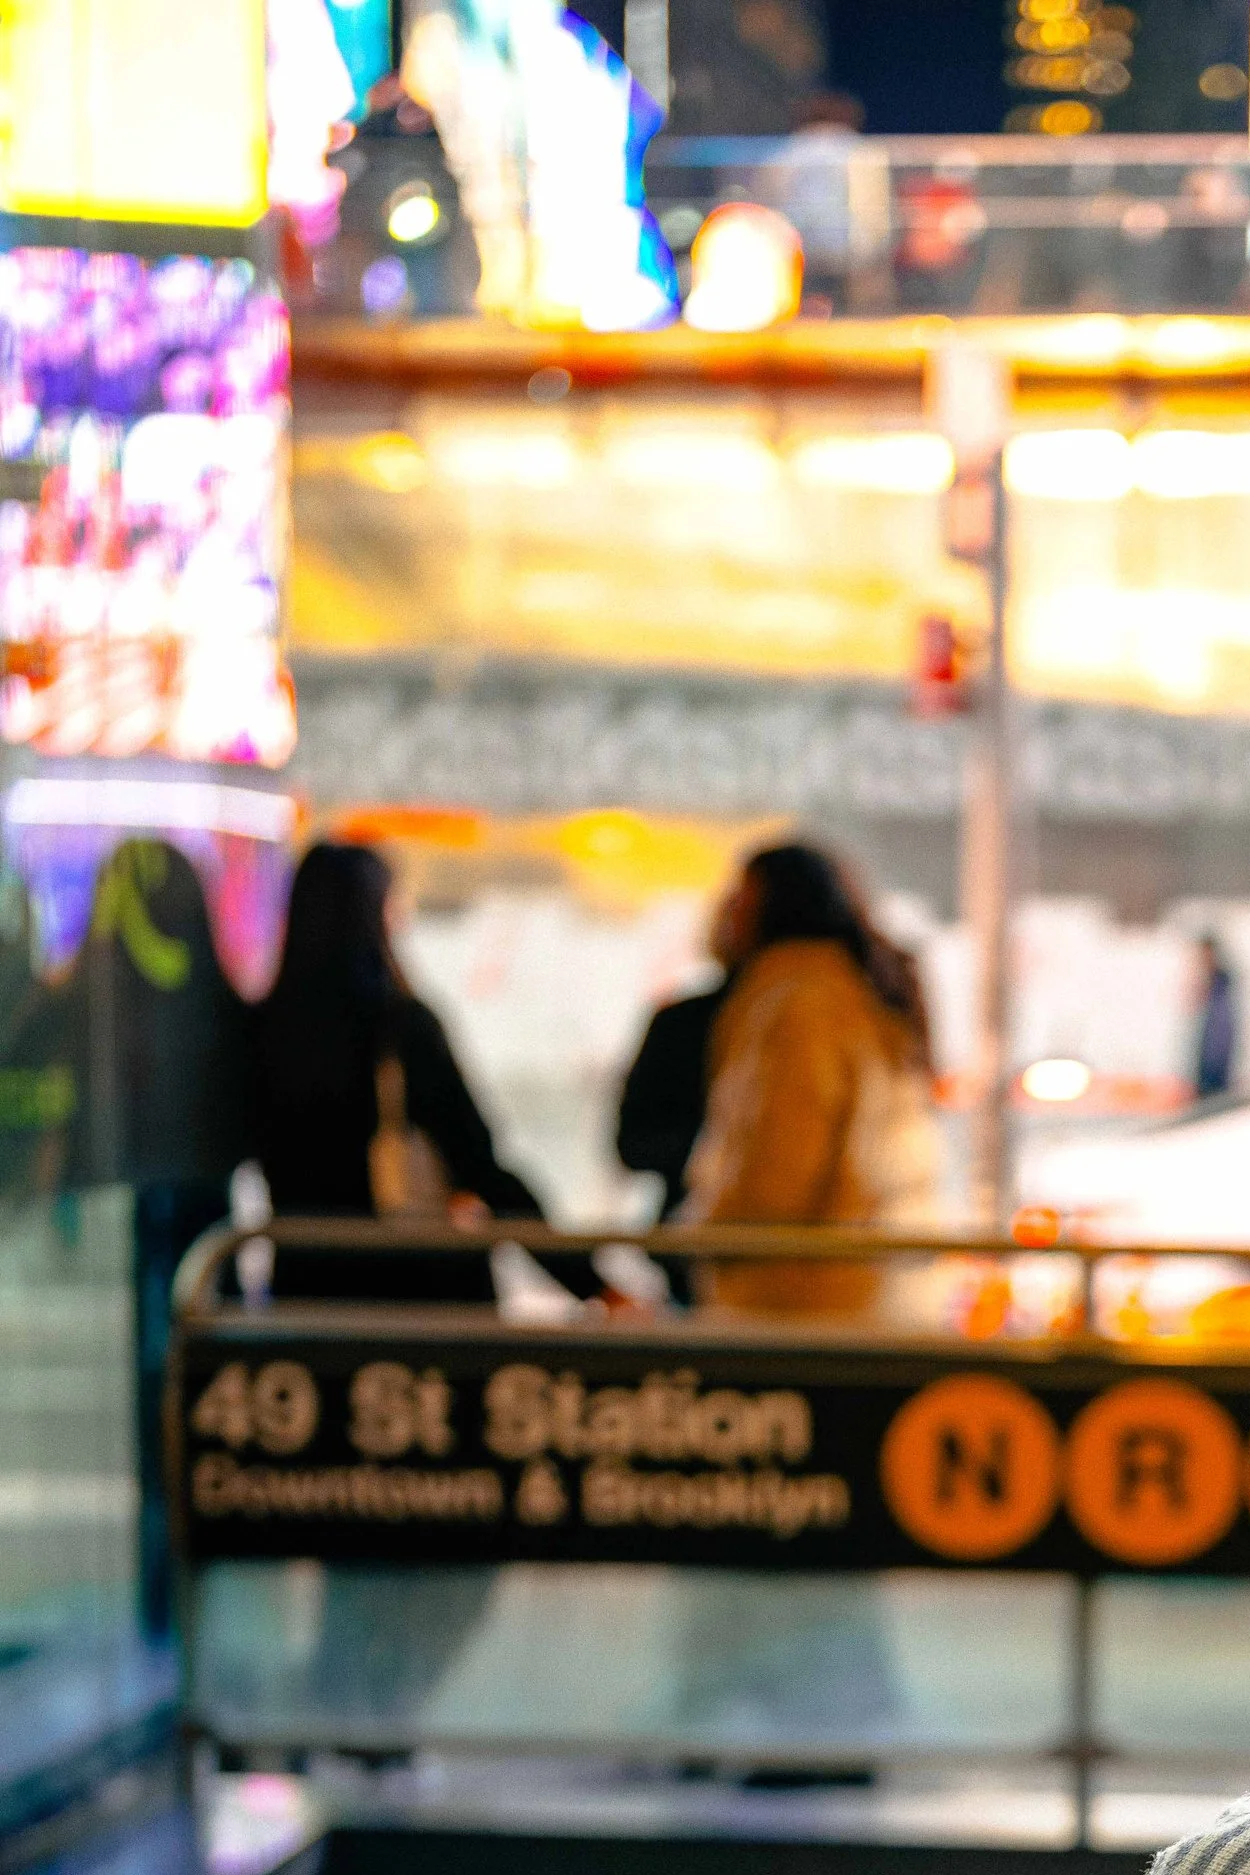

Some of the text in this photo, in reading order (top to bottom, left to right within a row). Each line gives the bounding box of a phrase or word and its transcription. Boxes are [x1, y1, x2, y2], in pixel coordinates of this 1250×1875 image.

[195, 1361, 811, 1462] 49 St Station
[194, 1461, 851, 1536] Downtown & Brooklyn
